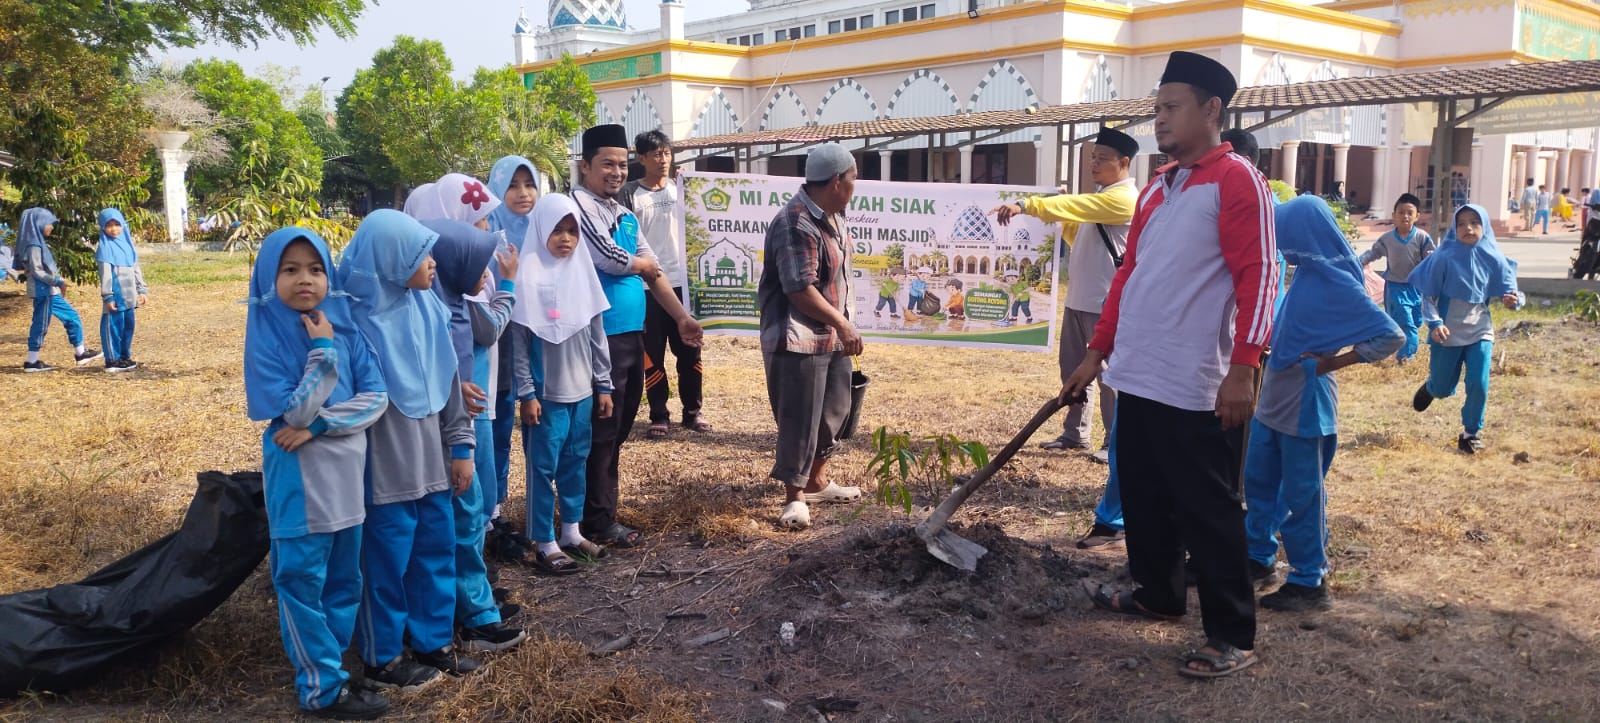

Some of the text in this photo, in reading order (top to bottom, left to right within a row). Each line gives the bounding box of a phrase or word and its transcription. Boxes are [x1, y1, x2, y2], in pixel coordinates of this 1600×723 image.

[739, 190, 762, 206] MI
[850, 195, 884, 212] YAH
[890, 197, 936, 215] SIAK
[708, 218, 929, 243] GERAKAN SIH MASJID
[846, 213, 880, 224] seskan
